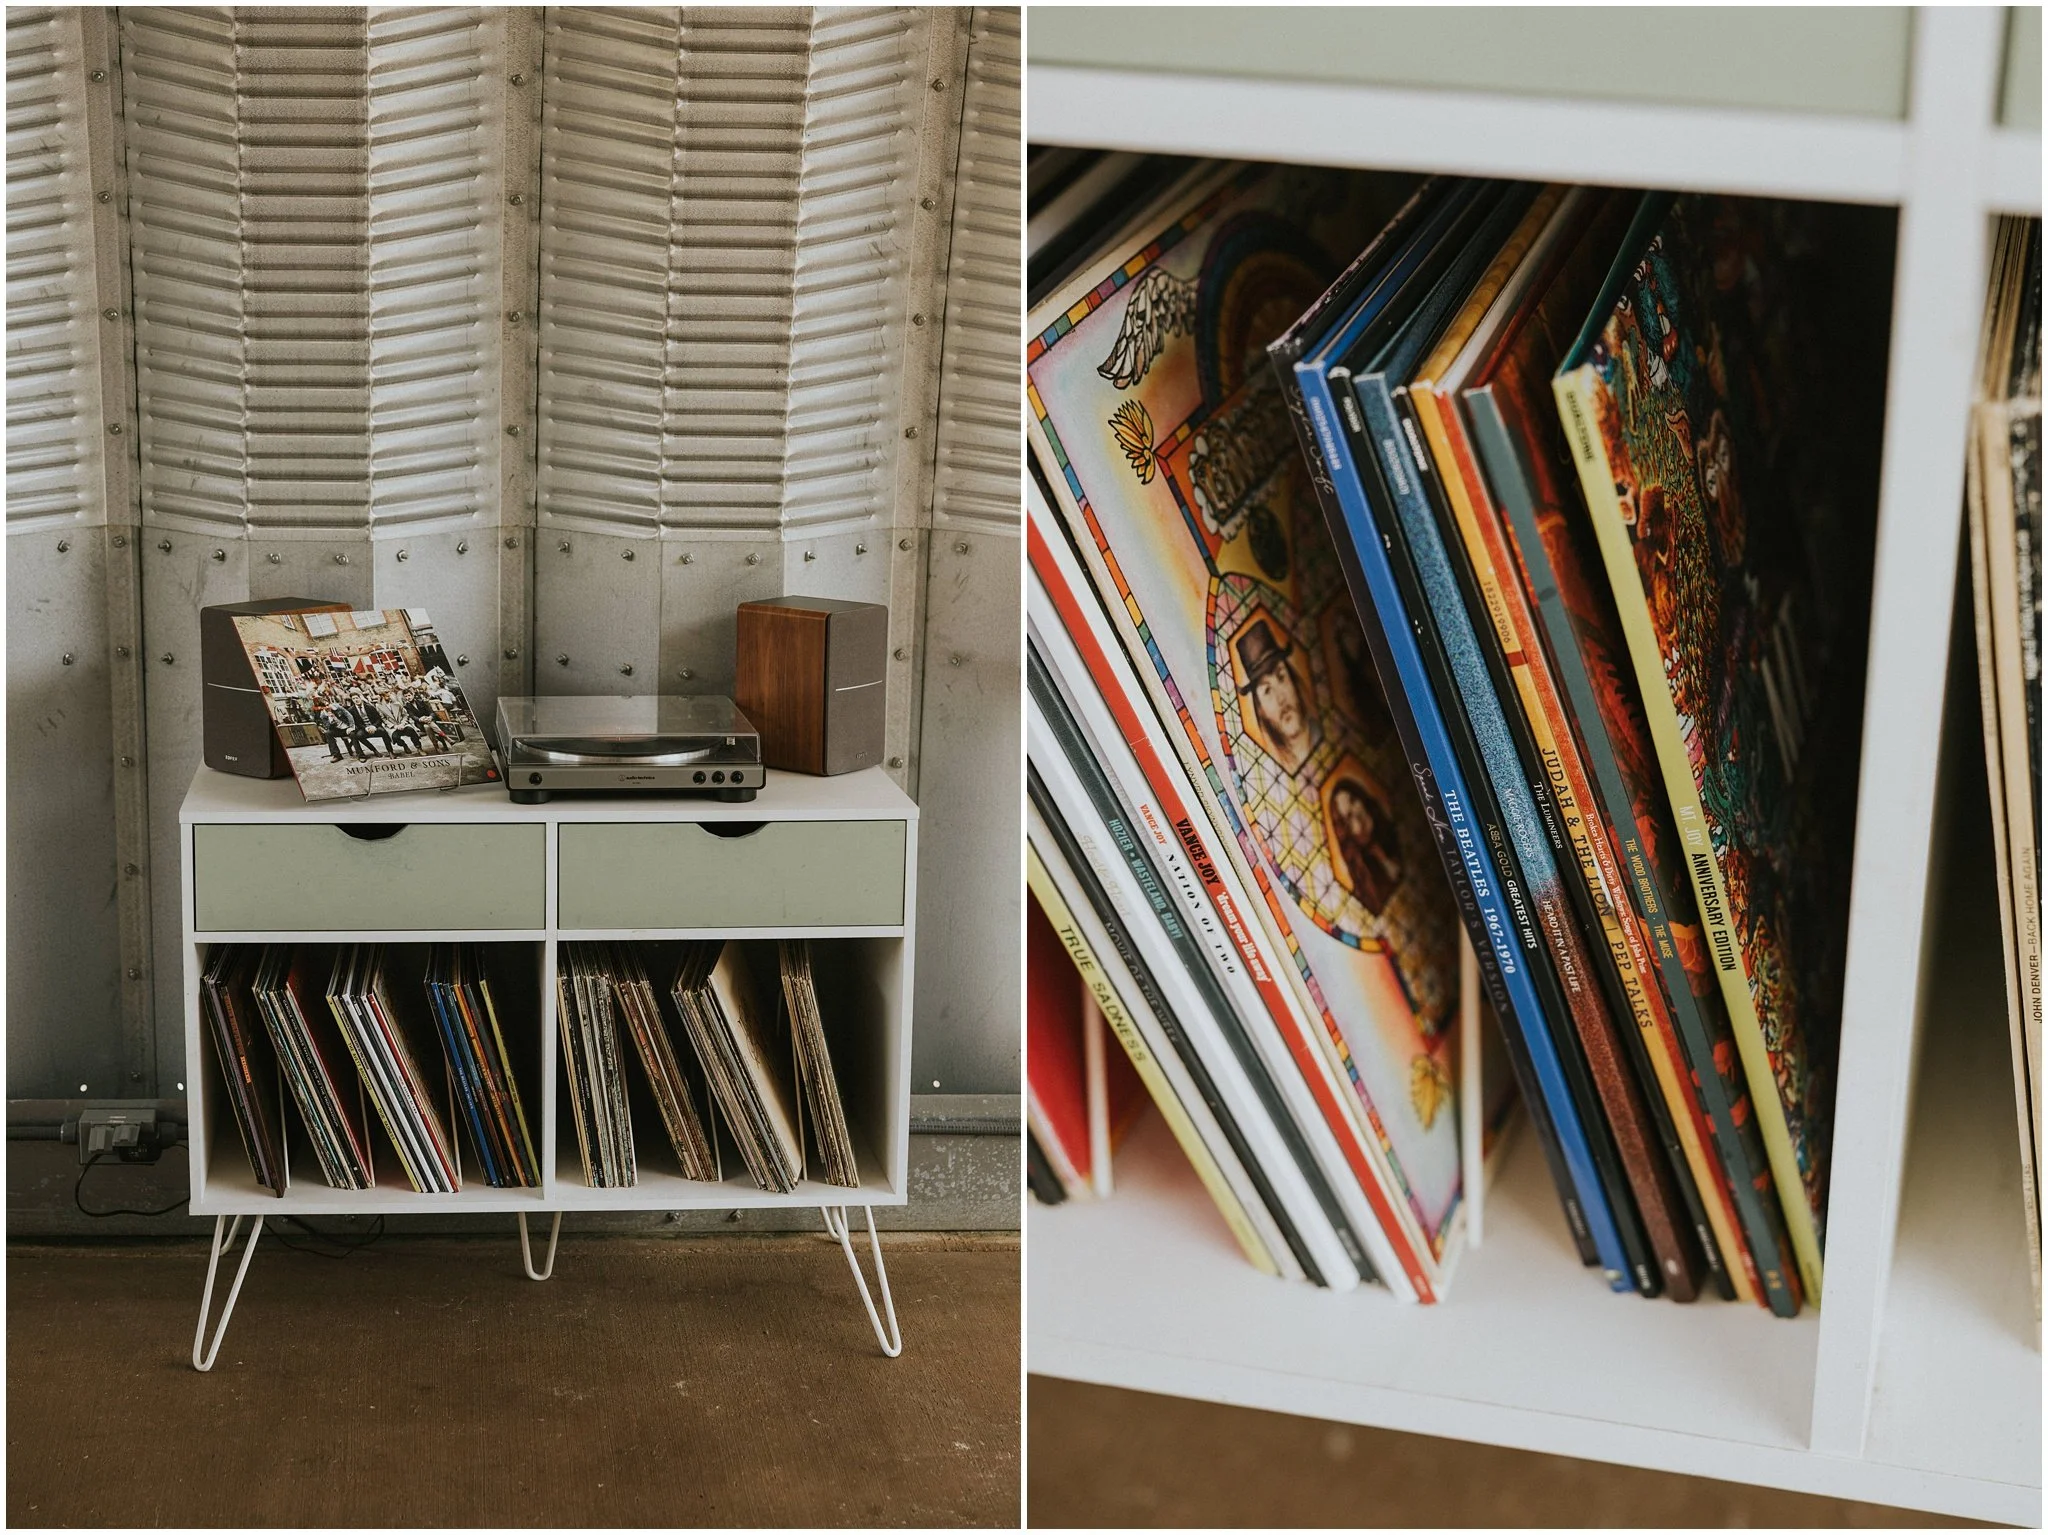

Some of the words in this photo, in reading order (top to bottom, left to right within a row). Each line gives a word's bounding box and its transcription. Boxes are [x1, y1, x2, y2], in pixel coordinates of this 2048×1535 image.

[1483, 582, 1510, 642] 1822919906
[388, 771, 416, 780] BABEL
[410, 762, 419, 770] &
[421, 758, 451, 769] SONS
[1504, 788, 1522, 824] MAGGIE
[1516, 823, 1533, 858] ROGERS
[1624, 838, 1637, 853] THE
[1109, 817, 1133, 851] HOZIER
[1131, 859, 1166, 912] WASTELAND,
[1161, 911, 1183, 940] BABY!
[1585, 813, 1599, 836] Broken
[1593, 837, 1607, 859] Hearts
[1602, 866, 1616, 885] Dirty
[1620, 917, 1634, 936] Songs
[1629, 854, 1646, 876] WOOD
[2024, 846, 2033, 881] AGAIN
[1139, 803, 1158, 830] VANCE
[1152, 828, 1167, 846] JOY
[1166, 853, 1200, 909] NATION
[1200, 916, 1215, 936] OF
[1214, 943, 1235, 975] TWO
[1175, 819, 1205, 860] VANCE
[1197, 859, 1220, 887] JOY
[1229, 921, 1249, 945] your
[1241, 941, 1258, 959] life
[1444, 789, 1464, 823] THE
[1457, 828, 1489, 895] BEATLES
[1484, 907, 1515, 973] 1967-1970
[1486, 822, 1502, 848] ABBA
[1495, 850, 1511, 877] GOLD
[1505, 880, 1530, 925] GREATEST
[1522, 927, 1537, 949] HITS
[1542, 746, 1573, 807] JUDAH
[1566, 814, 1580, 828] &
[1573, 834, 1594, 869] THE
[1587, 874, 1612, 916] LION
[1611, 940, 1631, 972] PEP
[1625, 978, 1651, 1028] TALKS
[1637, 876, 1658, 914] BROTHERS
[1541, 899, 1557, 928] HEARD
[1691, 852, 1723, 926] ANNIVERSARY
[1712, 929, 1735, 971] EDITION
[2026, 884, 2035, 913] HOME
[1445, 850, 1480, 926] TAYLOR'S
[1477, 940, 1510, 1012] VERSION
[1551, 927, 1561, 939] IT
[1554, 937, 1564, 949] IN
[1653, 923, 1666, 939] THE
[1557, 946, 1567, 956] A
[1658, 938, 1674, 960] MUSE
[1560, 955, 1574, 976] PAST
[1059, 925, 1095, 973] TRUE
[1093, 980, 1145, 1061] SADNESS
[1567, 976, 1580, 993] LIFE
[2033, 994, 2041, 1023] JOHN
[346, 1042, 354, 1052] THE
